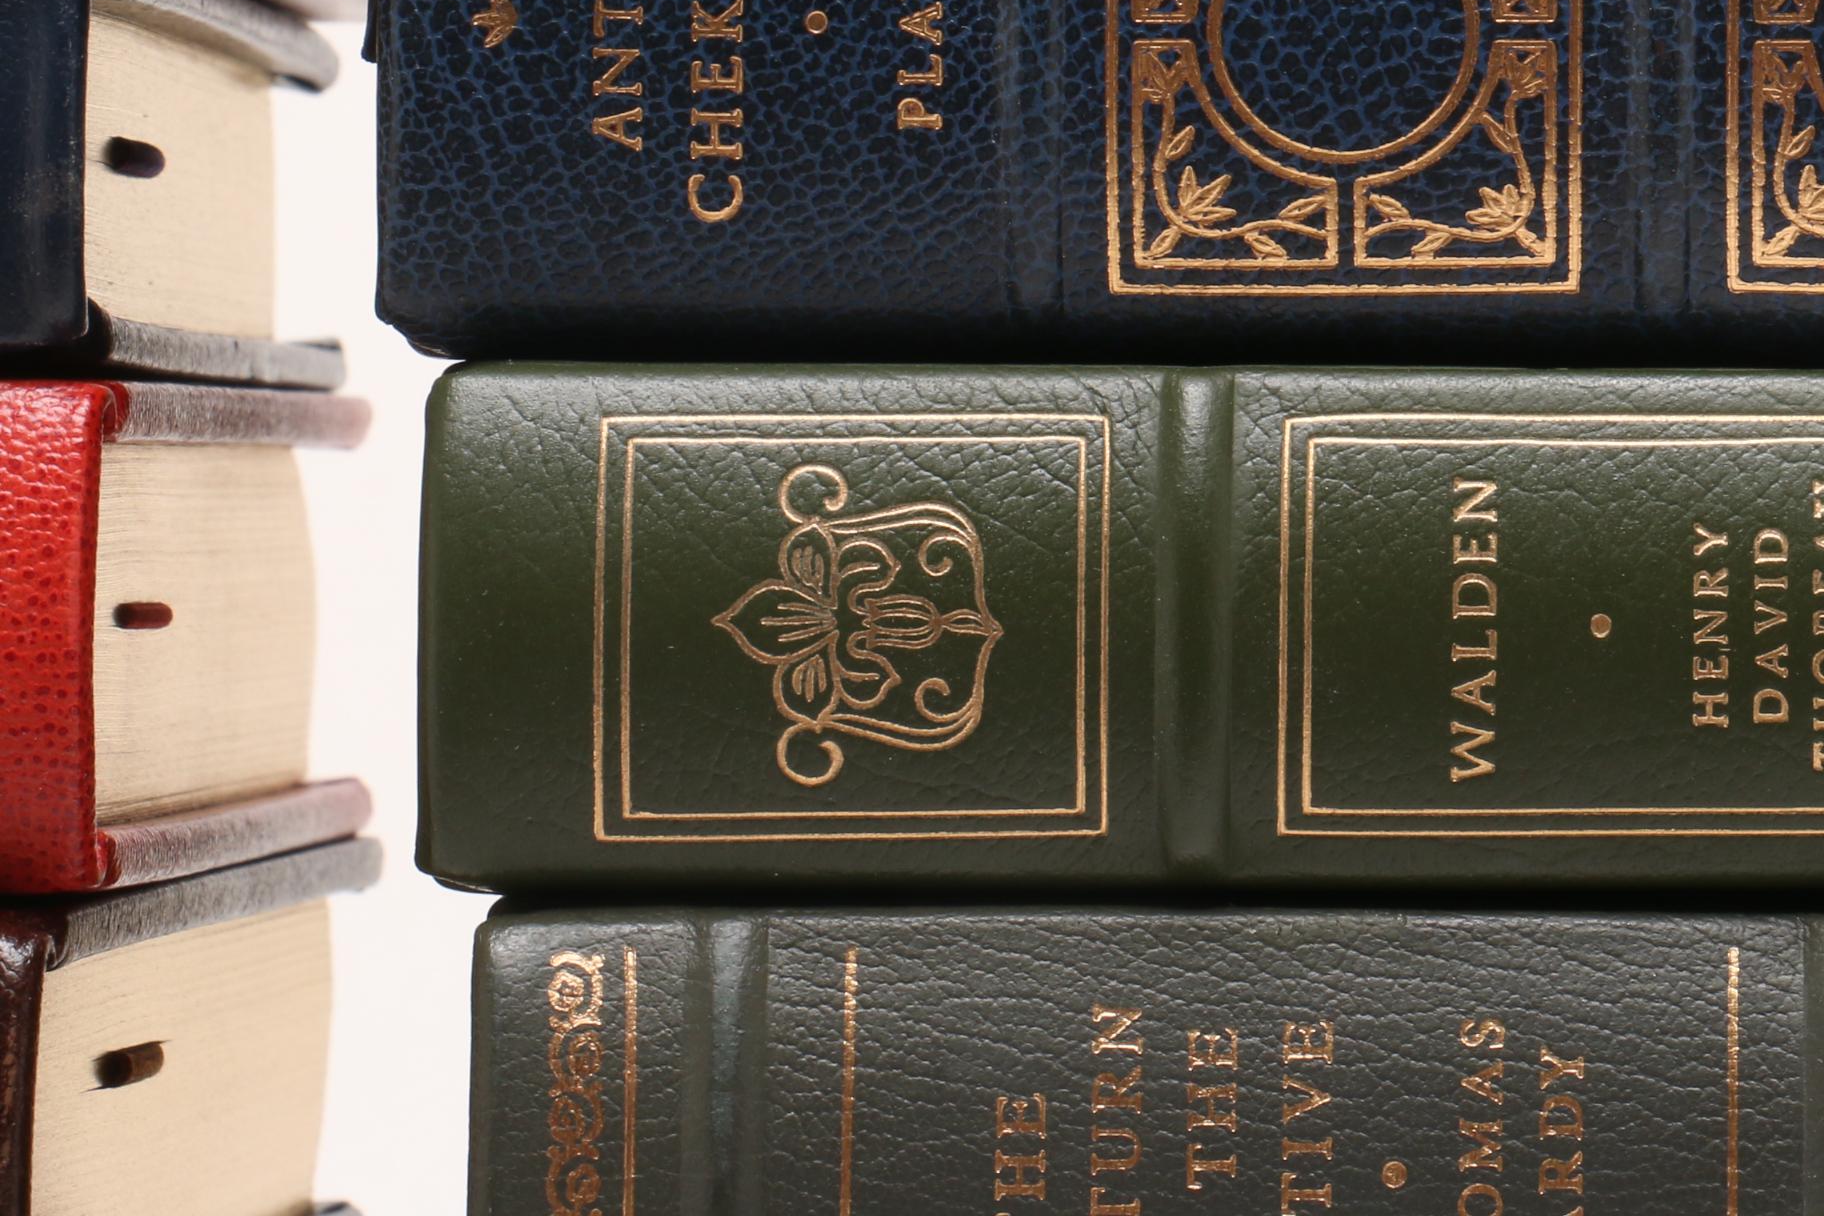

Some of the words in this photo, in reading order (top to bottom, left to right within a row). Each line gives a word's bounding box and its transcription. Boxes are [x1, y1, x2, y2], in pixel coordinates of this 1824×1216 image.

[1450, 476, 1498, 783] WALDEN
[1693, 522, 1730, 728] HENRY
[1753, 527, 1790, 724] DAVID
[994, 1092, 1048, 1216] HE
[1186, 1028, 1239, 1191] THE
[1280, 1019, 1335, 1216] TIVE
[1457, 1018, 1505, 1216] OMAS
[1538, 1045, 1585, 1216] RDY
